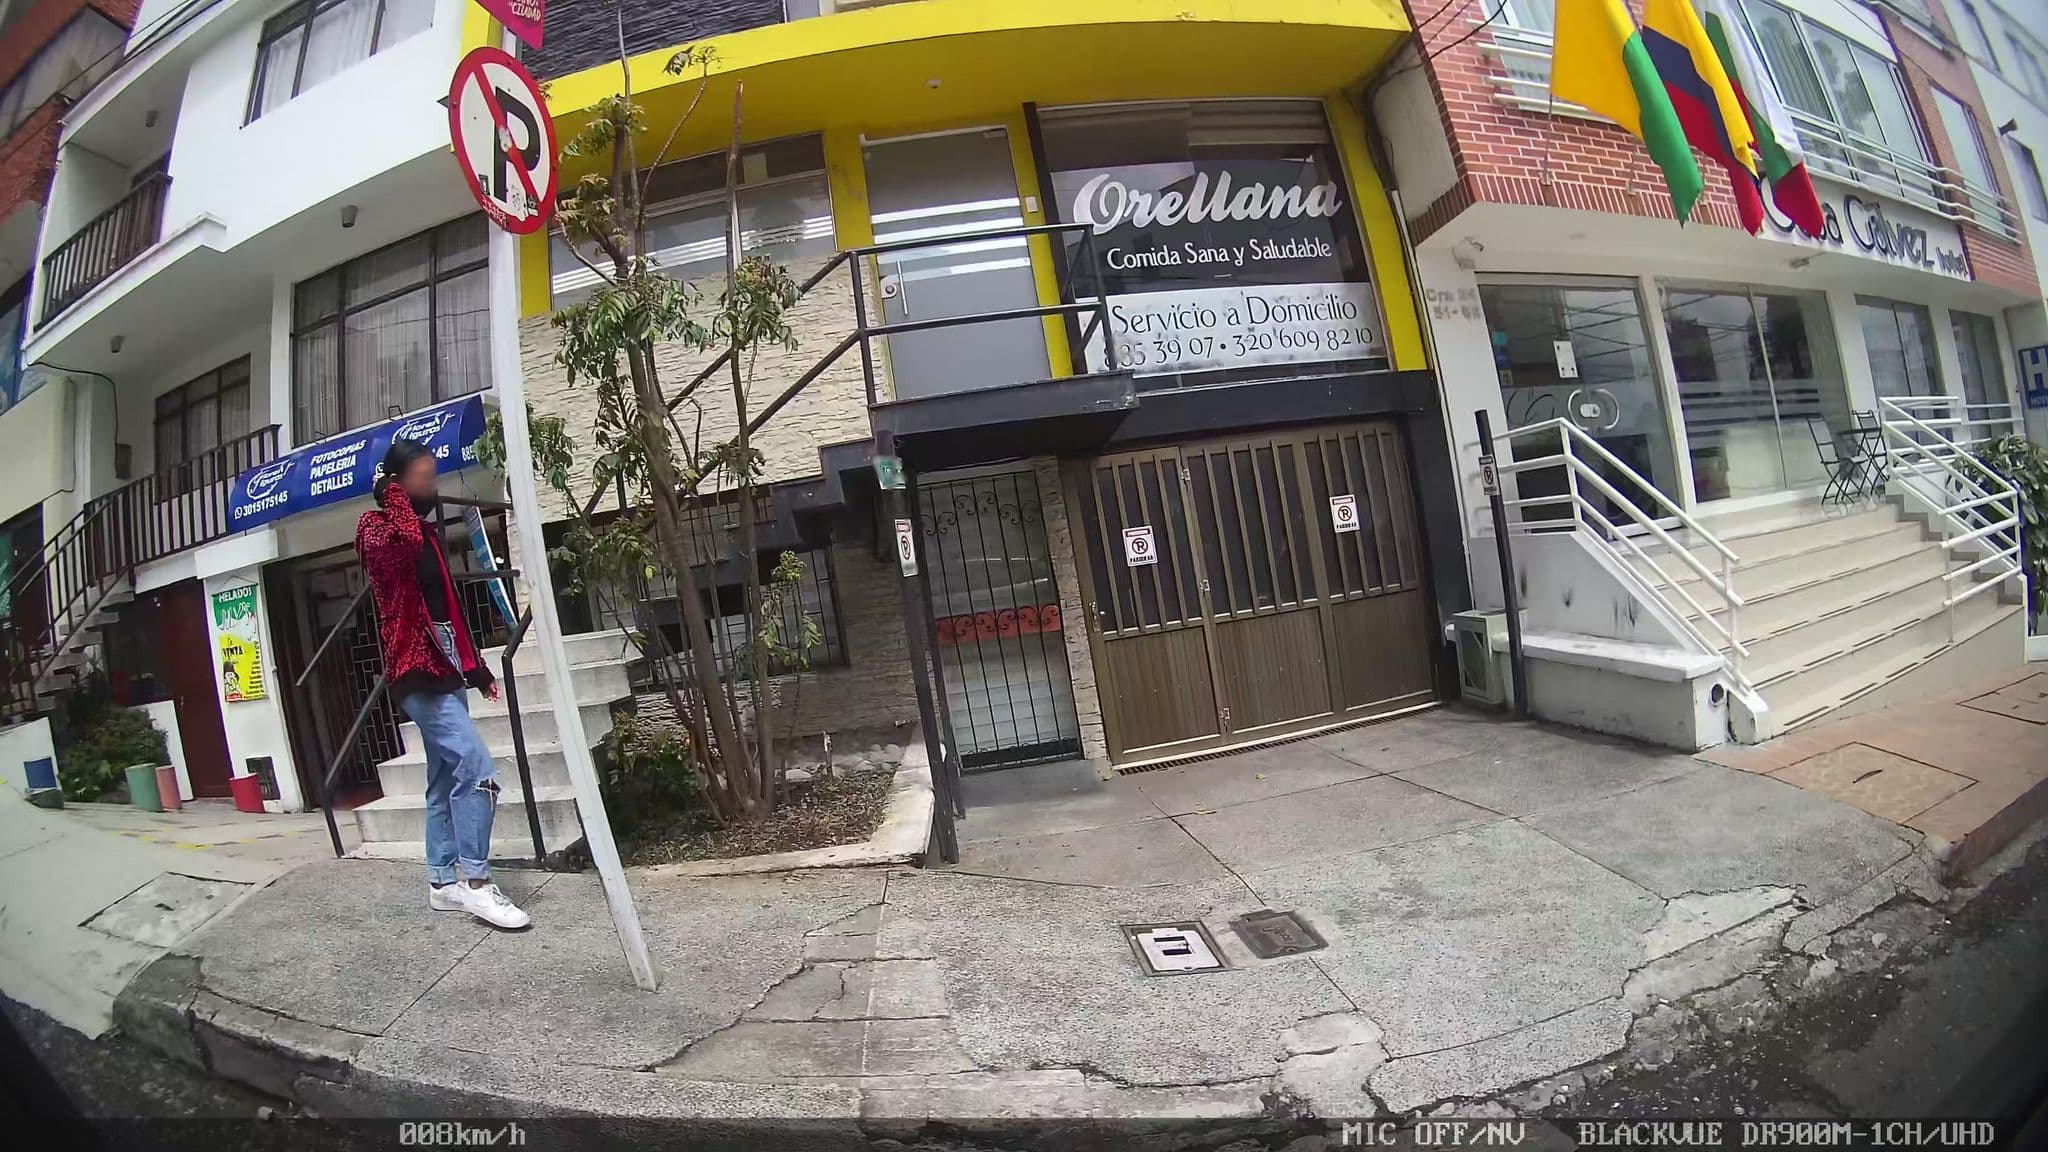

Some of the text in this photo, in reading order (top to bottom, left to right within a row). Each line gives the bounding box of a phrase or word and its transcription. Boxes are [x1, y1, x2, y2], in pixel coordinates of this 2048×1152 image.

[1073, 170, 1342, 235] Orellana
[1107, 237, 1332, 270] Comida Sana y Saludable
[1112, 294, 1357, 334] Servicio a Domicilio
[1154, 340, 1181, 364] 39
[1190, 337, 1214, 358] 07
[1235, 332, 1272, 357] 320
[1279, 327, 1320, 352] 609
[310, 440, 366, 465] FOTOCOPIAS
[310, 455, 356, 479] PAPELERIA
[311, 472, 353, 496] DETALLES
[243, 491, 288, 517] 3015175145
[219, 586, 252, 603] HELADOS
